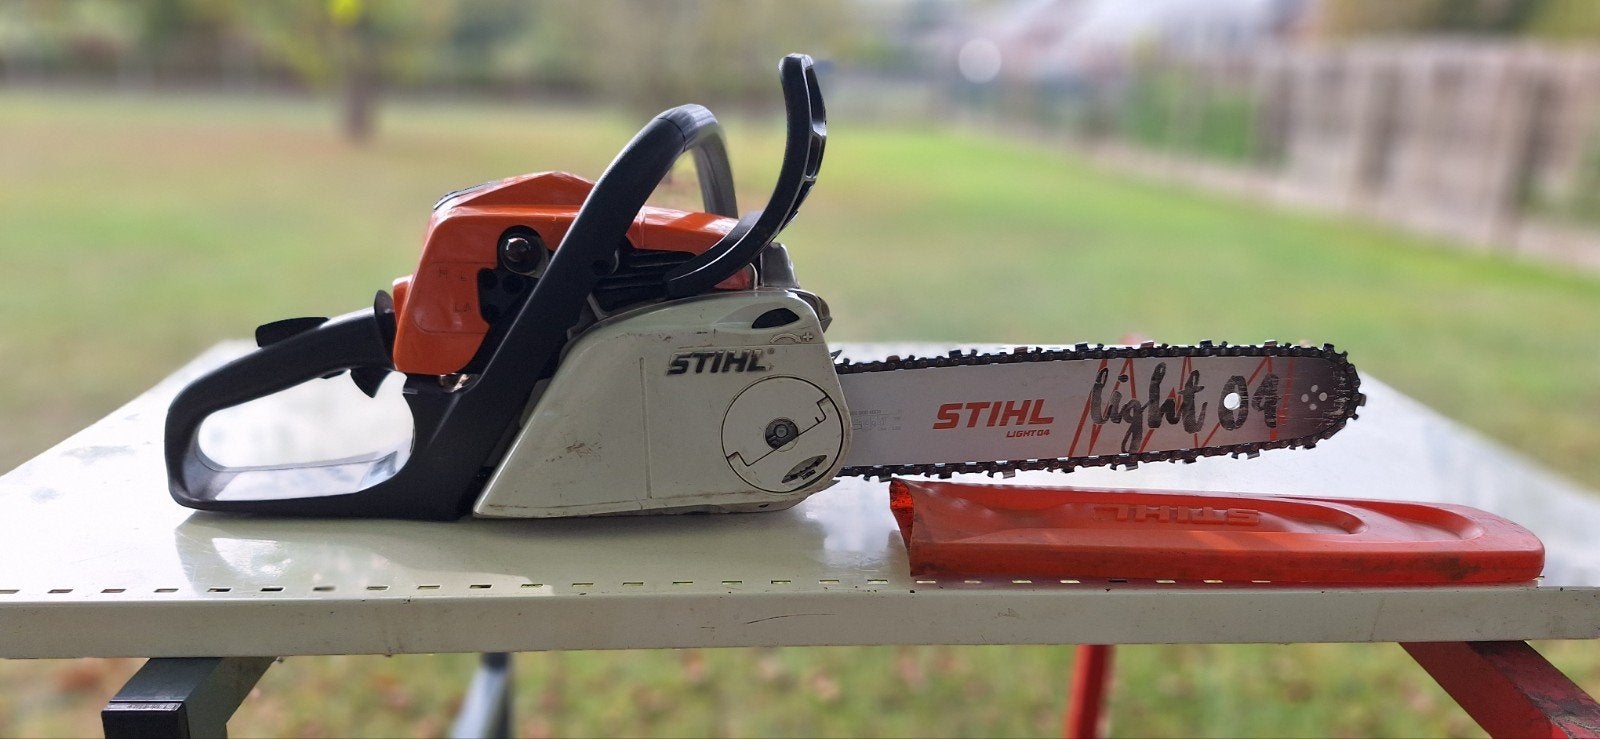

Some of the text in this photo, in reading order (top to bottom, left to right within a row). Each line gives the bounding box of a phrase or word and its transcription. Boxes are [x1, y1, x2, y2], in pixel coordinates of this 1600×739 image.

[666, 350, 767, 376] STIHL
[932, 399, 1054, 430] STIHL
[1091, 361, 1281, 453] light 04
[1093, 504, 1260, 526] STIHL
